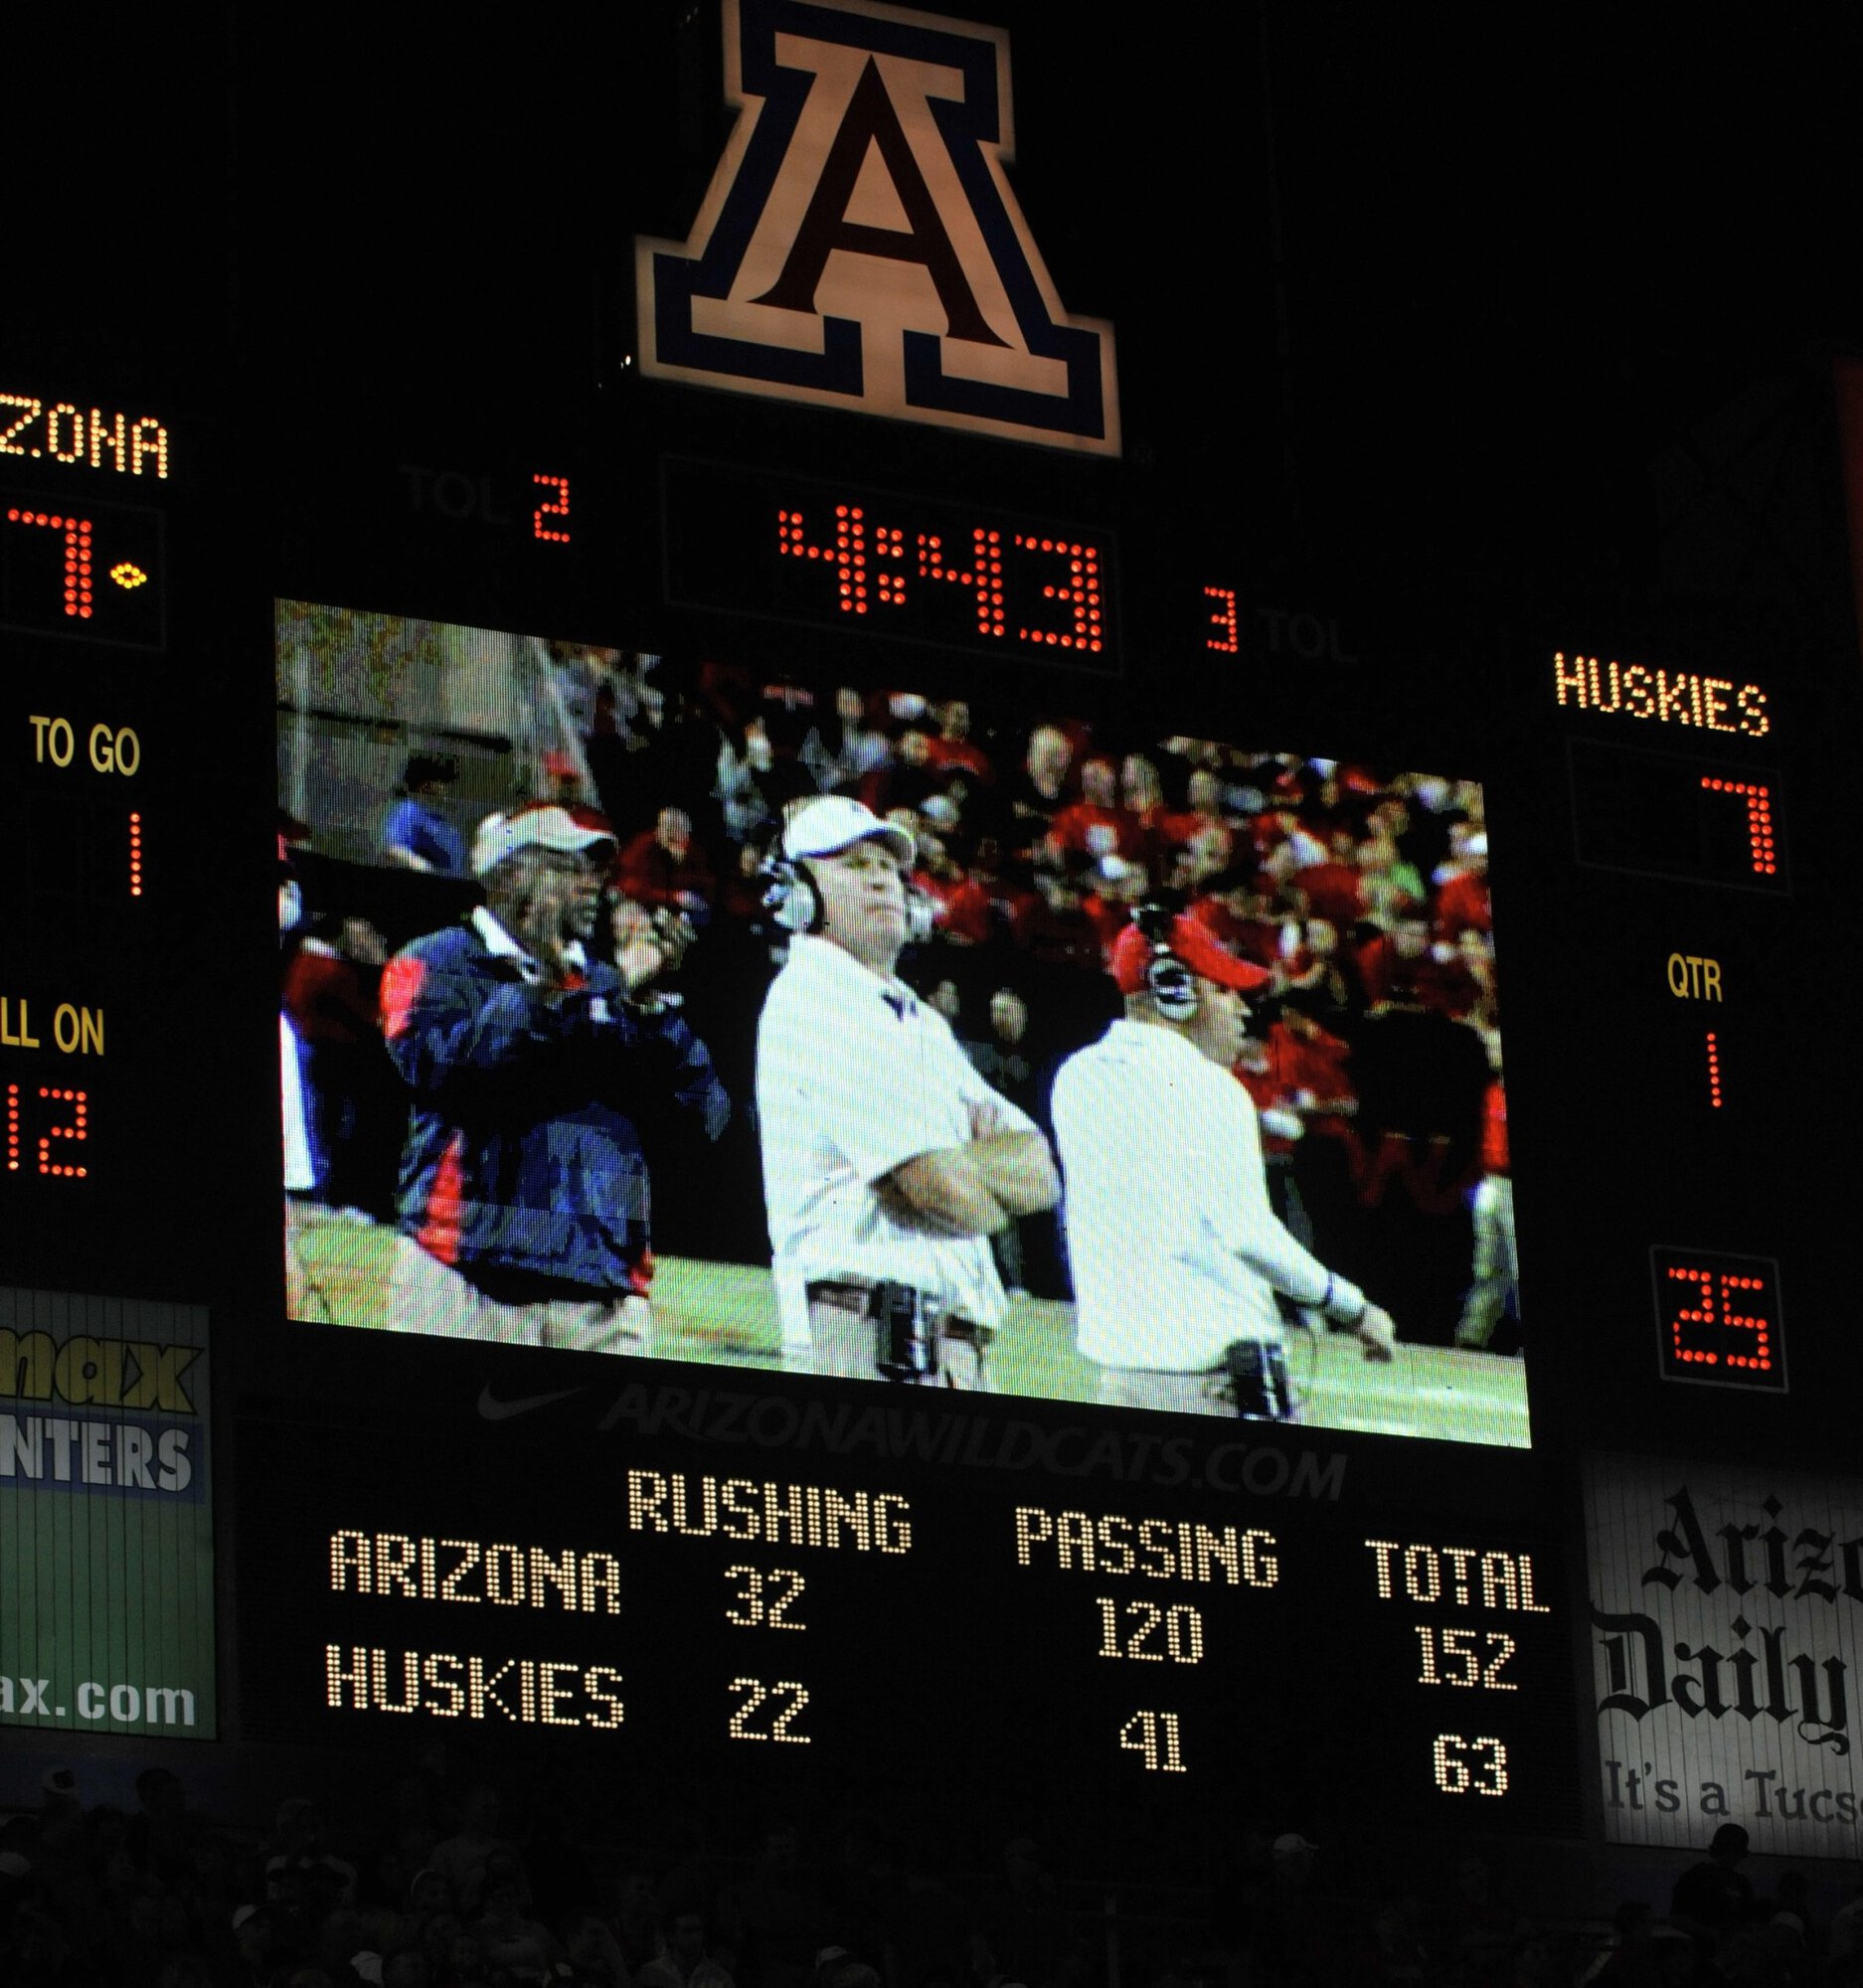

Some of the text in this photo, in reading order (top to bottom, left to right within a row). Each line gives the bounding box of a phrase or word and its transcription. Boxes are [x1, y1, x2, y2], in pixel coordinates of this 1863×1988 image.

[400, 464, 510, 527] TOL
[532, 472, 572, 544] 2
[7, 507, 93, 619] 7
[776, 504, 1103, 653] 4:43
[1203, 584, 1239, 655] 3
[1257, 606, 1358, 666] TOL
[1554, 652, 1771, 738] HUSKIES
[28, 714, 141, 777] TO GO
[1700, 775, 1778, 876] 7
[1666, 951, 1723, 1003] QTR
[54, 1002, 104, 1057] ON
[7, 1082, 88, 1179] 12
[1667, 1265, 1773, 1371] 25
[599, 1383, 1348, 1502] ARIZONAWILDCATS.COM
[627, 1469, 1551, 1613] RUSHING PASSING TOTAL
[329, 1529, 1519, 1691] ARIZONA 32 120 152
[325, 1643, 1509, 1796] HUSKIES 22 41 63
[1591, 1601, 1850, 1755] Daily
[1606, 1760, 1863, 1825] It's a Tucs
